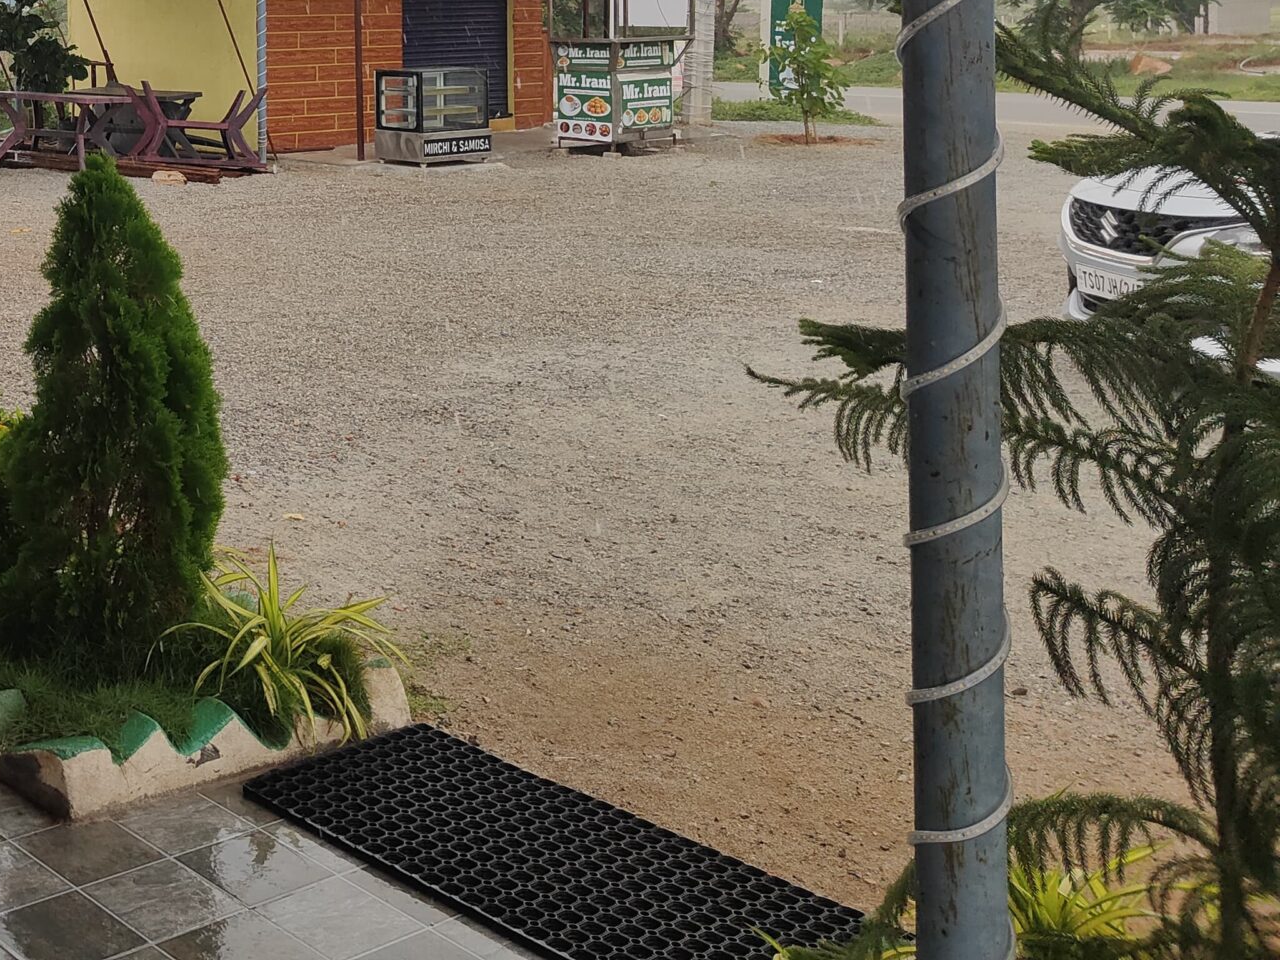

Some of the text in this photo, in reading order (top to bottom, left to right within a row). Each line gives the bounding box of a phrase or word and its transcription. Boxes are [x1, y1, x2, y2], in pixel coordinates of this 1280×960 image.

[586, 47, 610, 58] Irani
[640, 42, 662, 57] Irani
[580, 74, 612, 89] Irani
[643, 80, 671, 98] Irani
[424, 141, 450, 155] MIRCHI
[459, 138, 490, 152] SAMOSA
